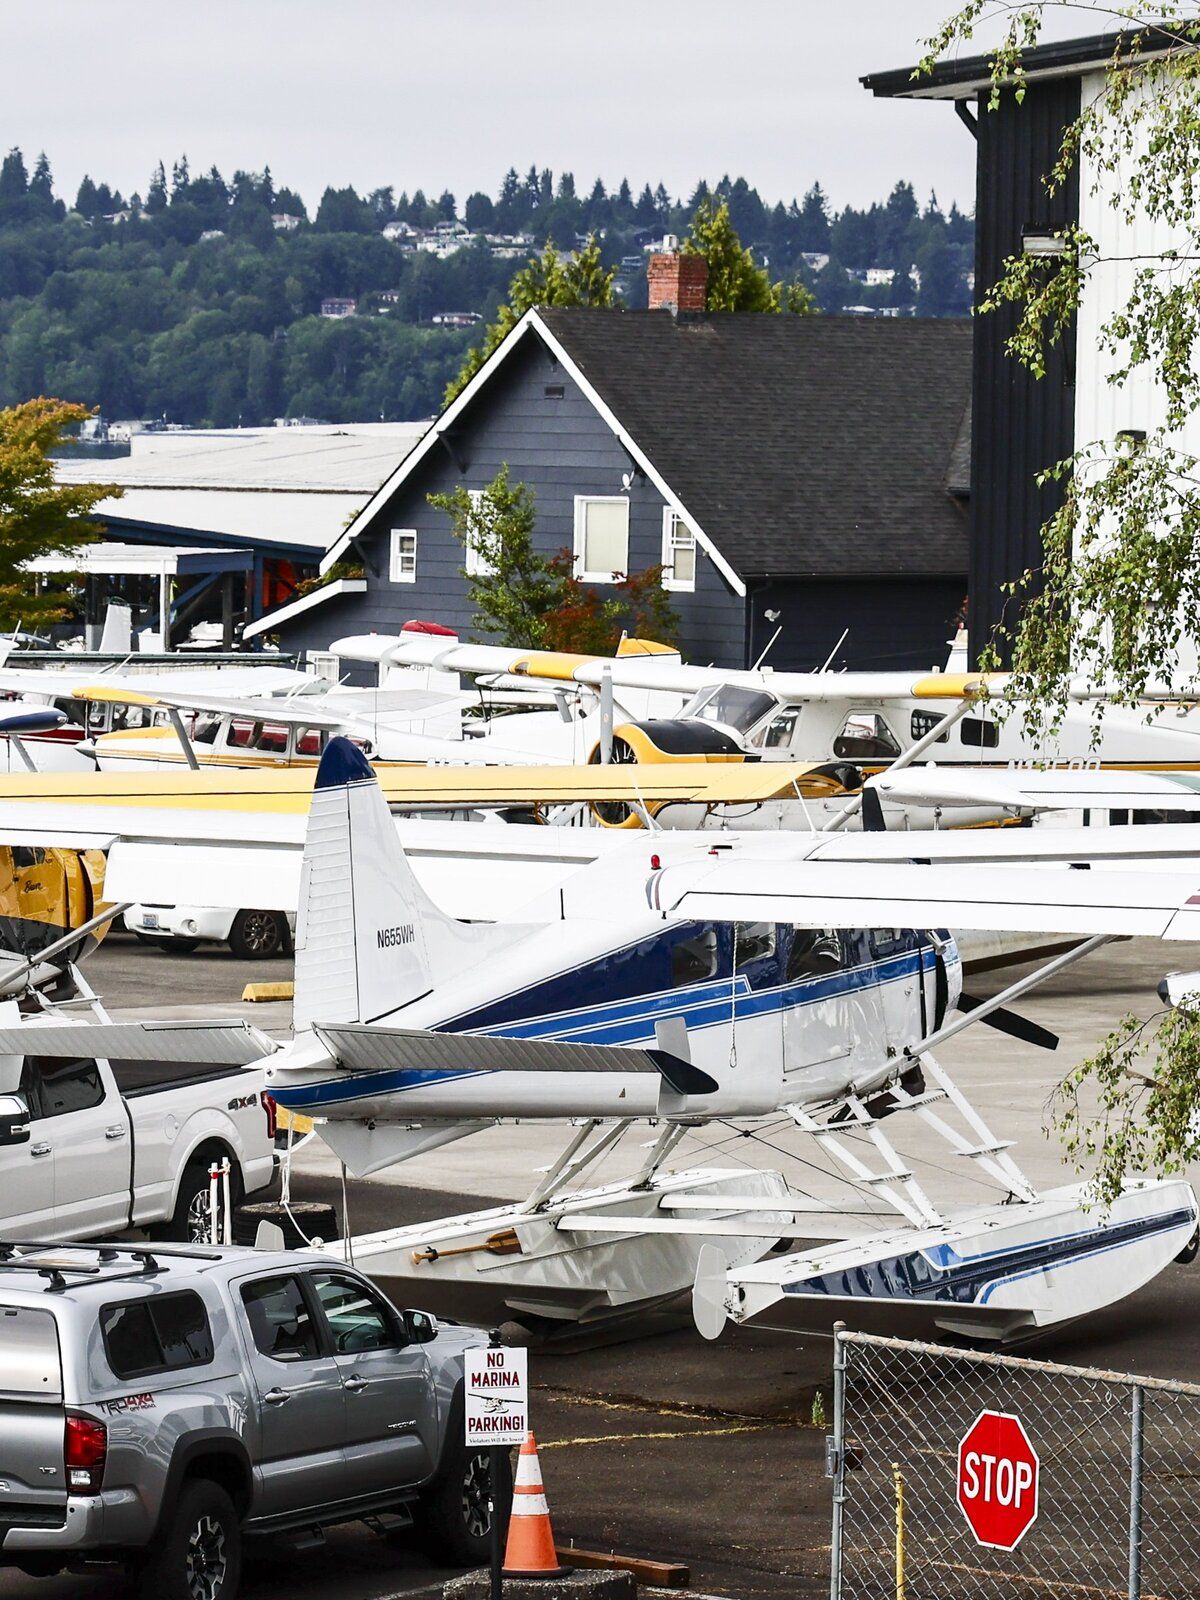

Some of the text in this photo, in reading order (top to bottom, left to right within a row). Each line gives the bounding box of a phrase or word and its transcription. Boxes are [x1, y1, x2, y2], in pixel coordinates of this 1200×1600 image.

[377, 924, 415, 949] N655WH
[487, 1352, 504, 1367] NO
[471, 1371, 520, 1387] MARINA
[468, 1415, 524, 1432] PARKING!
[963, 1452, 1032, 1509] STOP
